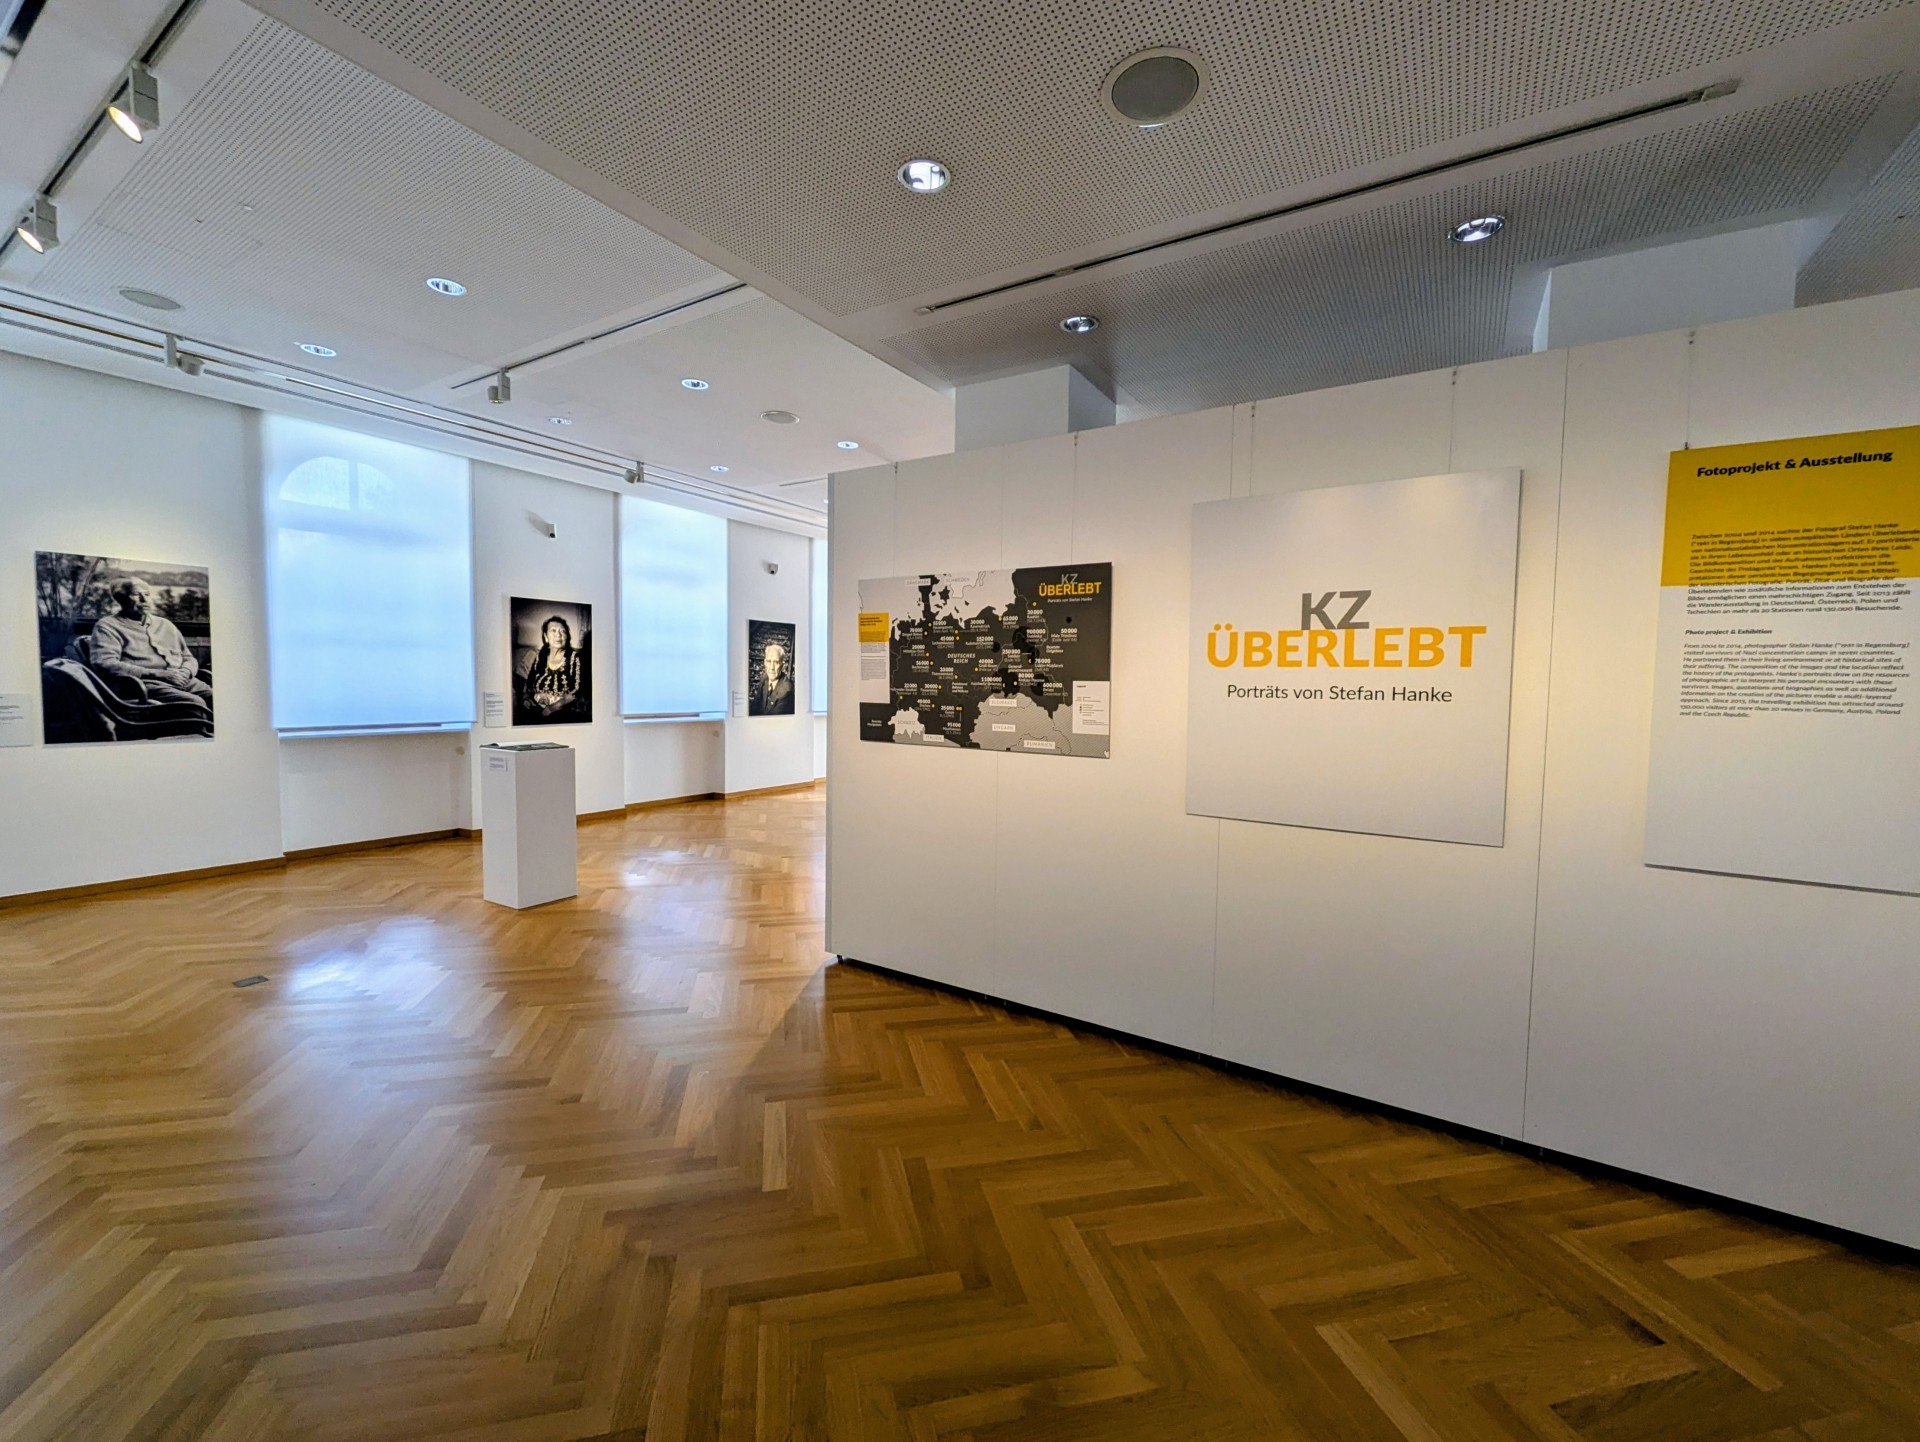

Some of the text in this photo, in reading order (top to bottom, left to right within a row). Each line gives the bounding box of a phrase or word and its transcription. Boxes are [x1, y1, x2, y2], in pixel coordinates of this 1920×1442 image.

[1697, 451, 1893, 477] Fotoprojekt & Ausstellung
[1039, 582, 1102, 596] ÜBERLEBT
[1061, 574, 1078, 584] KZ
[1301, 589, 1372, 631] KZ
[1207, 623, 1487, 668] ÜBERLEBT
[1227, 684, 1453, 702] Porträts von Stefan Hanke
